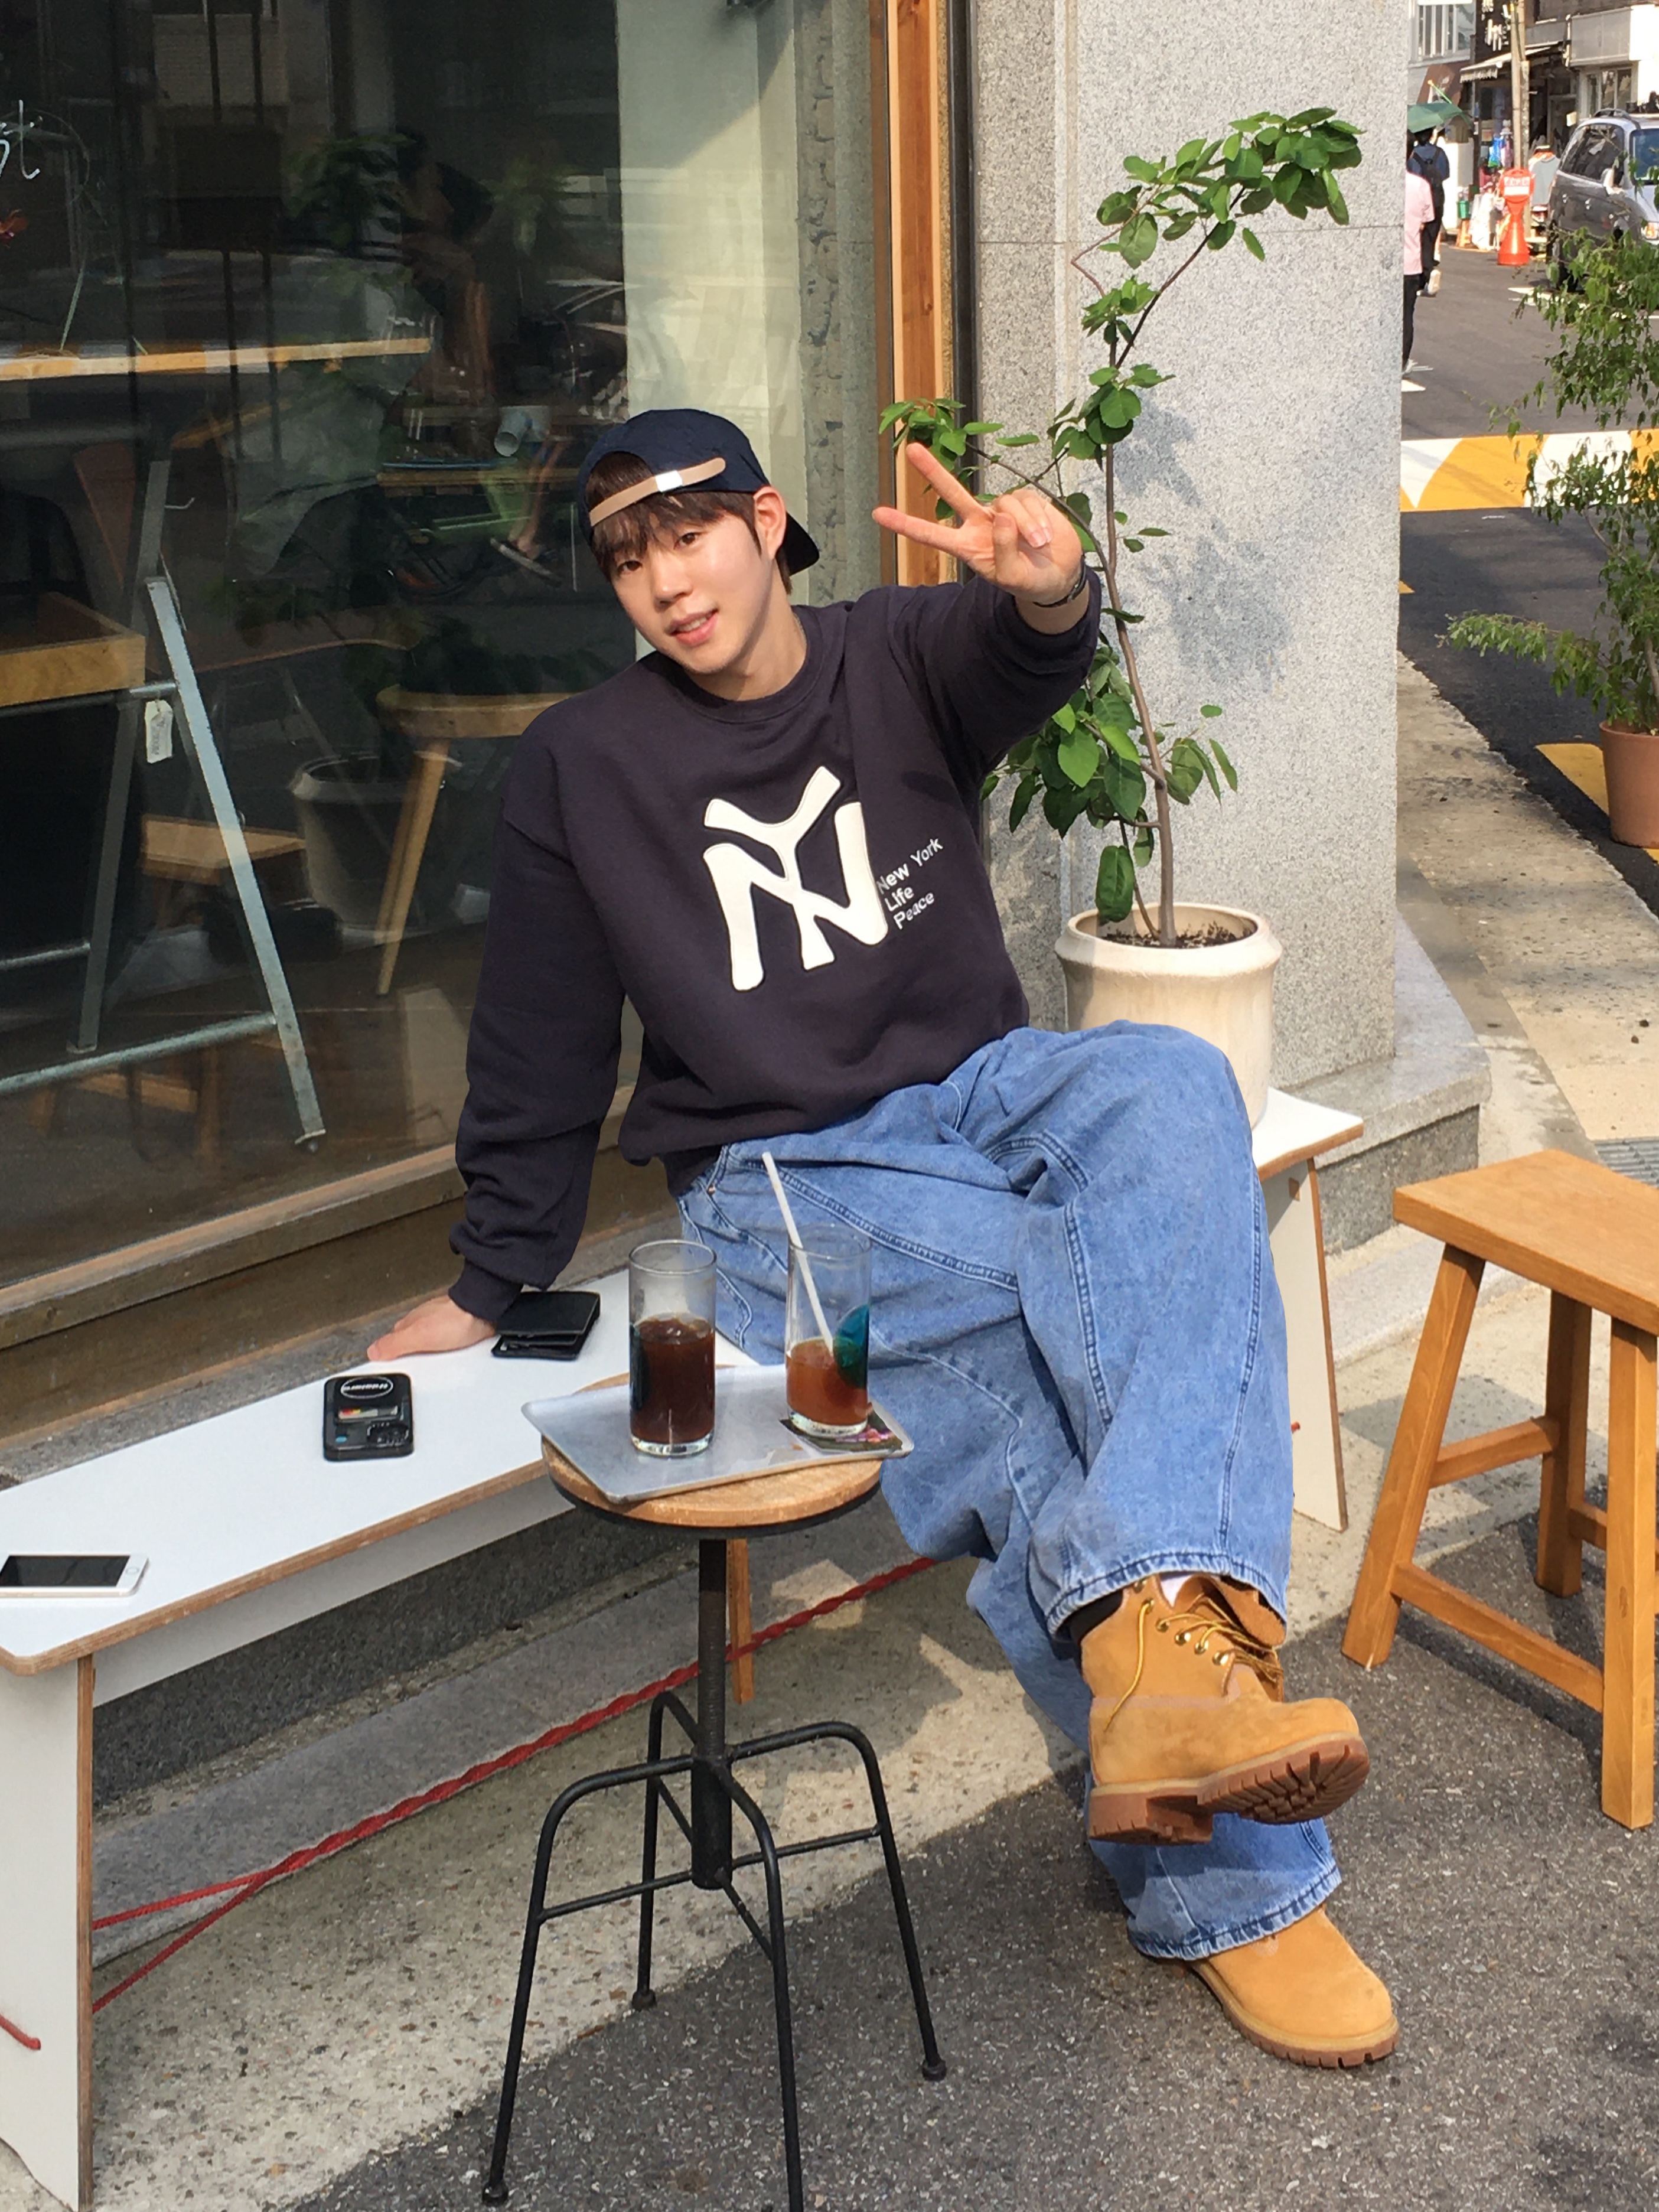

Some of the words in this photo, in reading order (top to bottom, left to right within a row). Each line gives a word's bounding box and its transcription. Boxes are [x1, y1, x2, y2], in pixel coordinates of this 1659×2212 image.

[876, 863, 910, 895] New
[910, 838, 943, 866] York
[884, 887, 914, 911] Life
[893, 892, 934, 930] Peace
